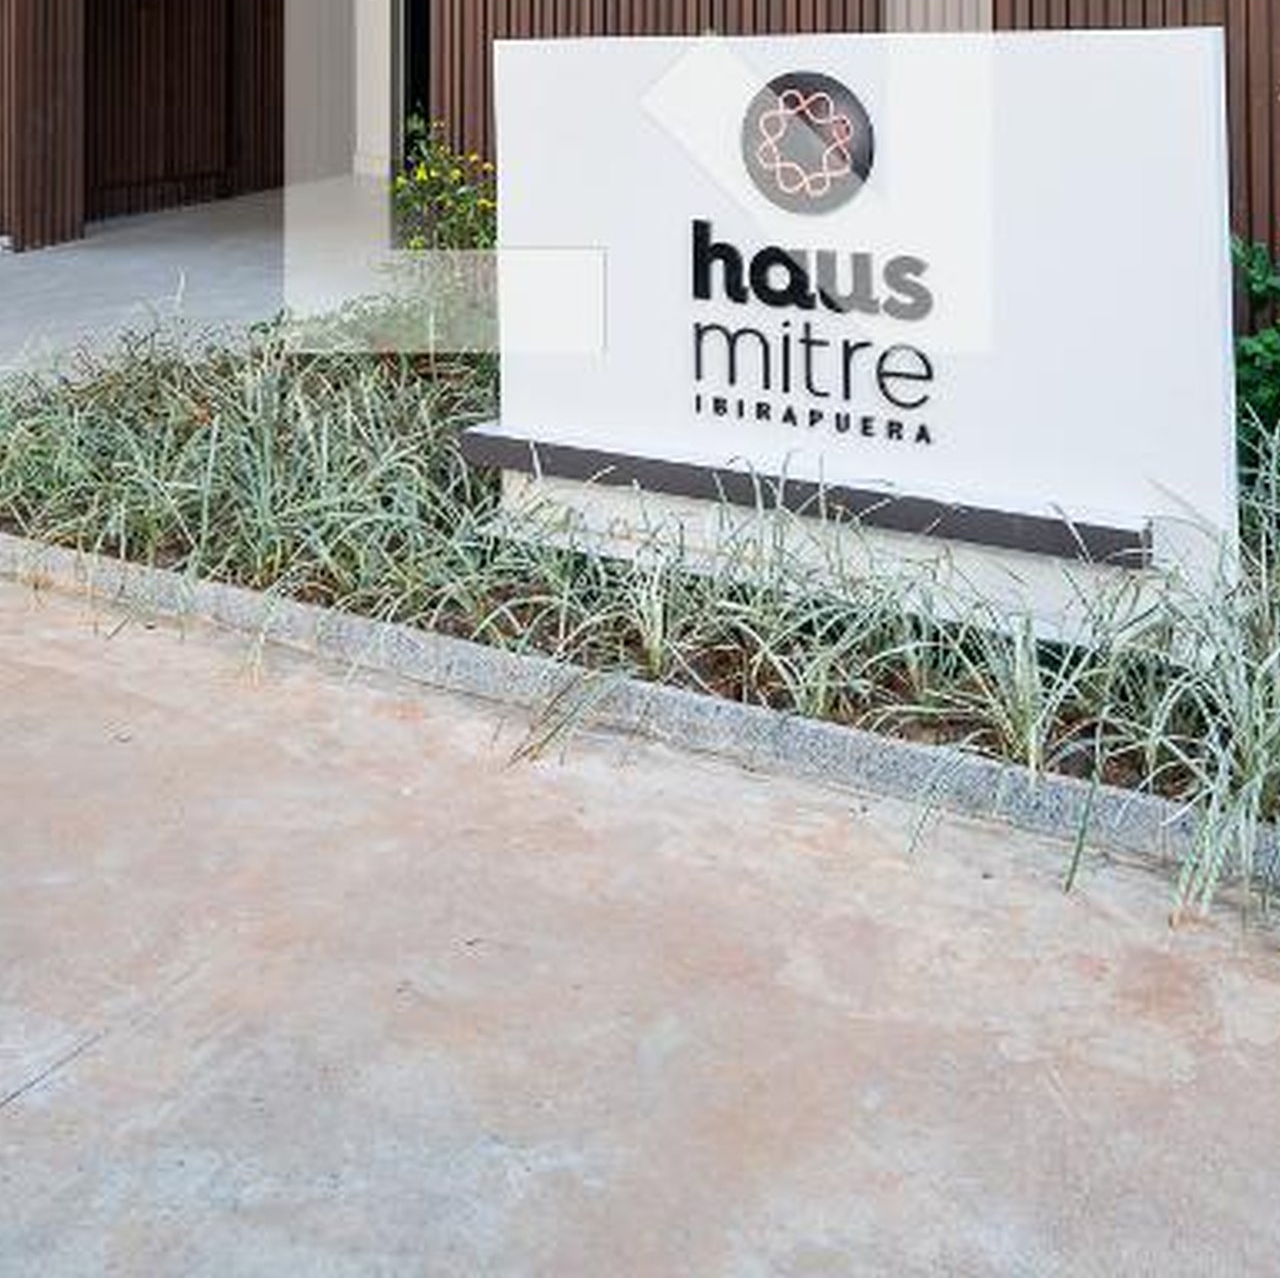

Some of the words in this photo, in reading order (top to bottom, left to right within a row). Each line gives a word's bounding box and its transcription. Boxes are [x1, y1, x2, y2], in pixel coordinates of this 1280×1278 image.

[692, 219, 934, 322] haus
[693, 320, 934, 410] mitre
[695, 393, 933, 444] IBIRAPUERA
